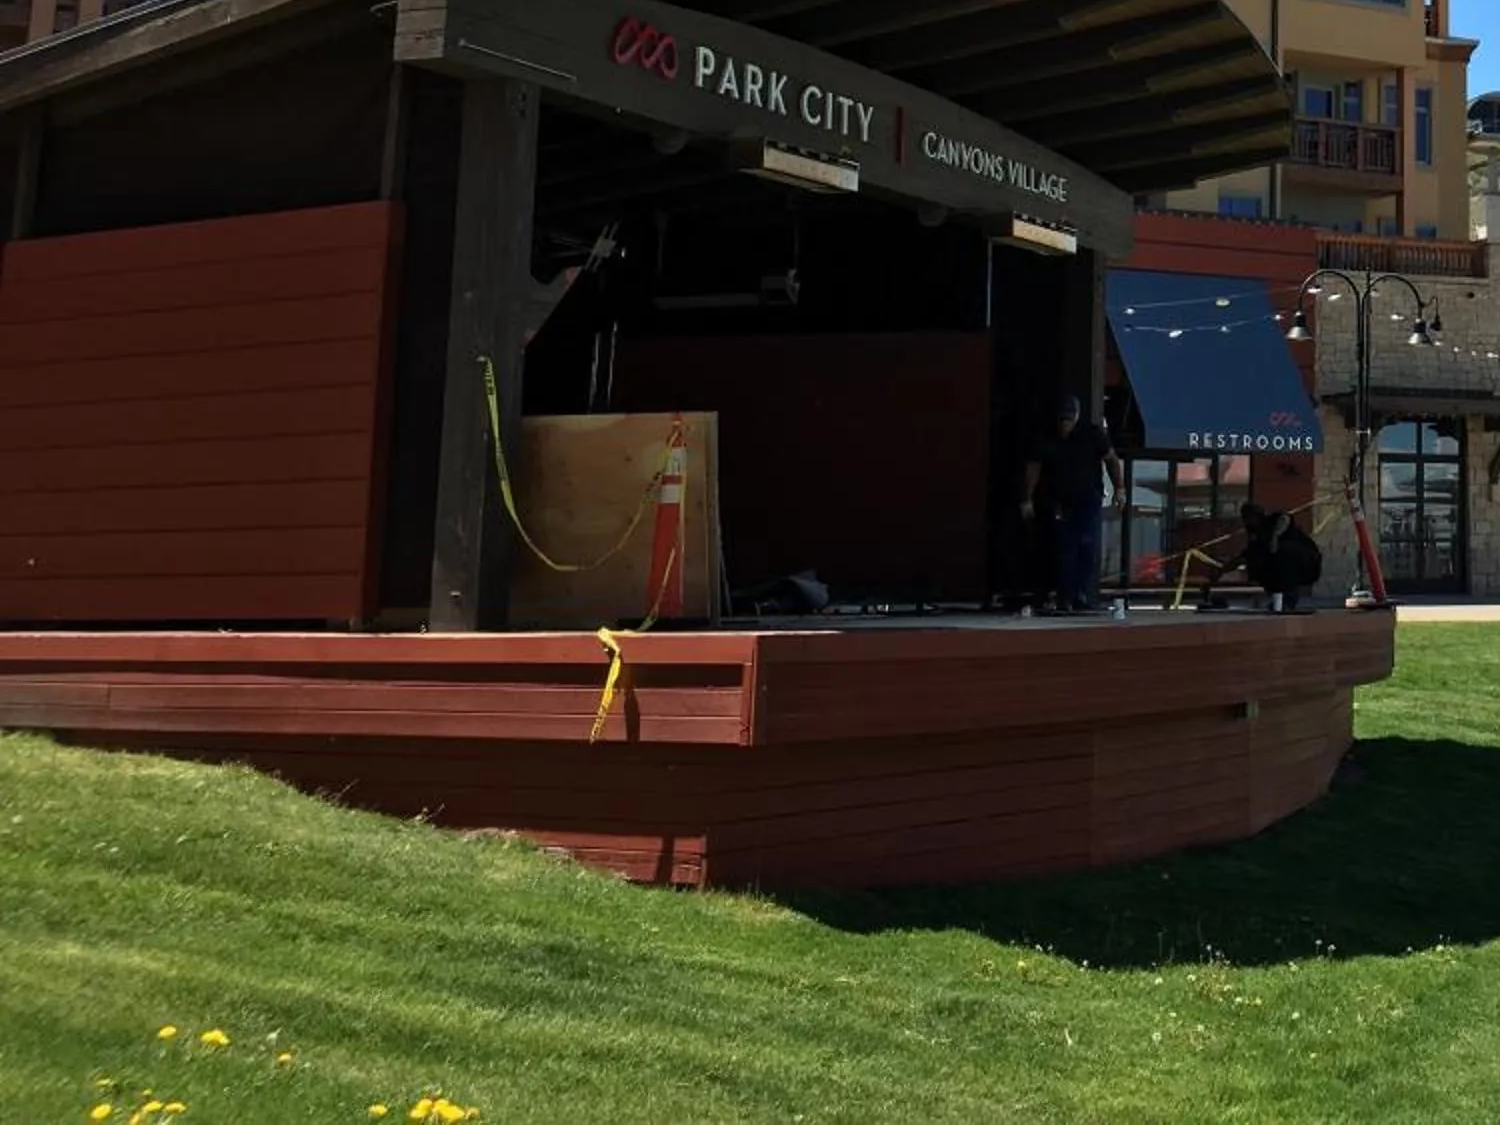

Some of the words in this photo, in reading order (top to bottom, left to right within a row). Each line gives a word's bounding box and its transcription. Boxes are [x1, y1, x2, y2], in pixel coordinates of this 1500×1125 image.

[695, 46, 788, 116] PARK
[801, 85, 874, 143] CITY
[924, 131, 1003, 182] CANYONS
[1008, 159, 1068, 202] VILLAGE
[1189, 432, 1313, 451] RESTROOMS
